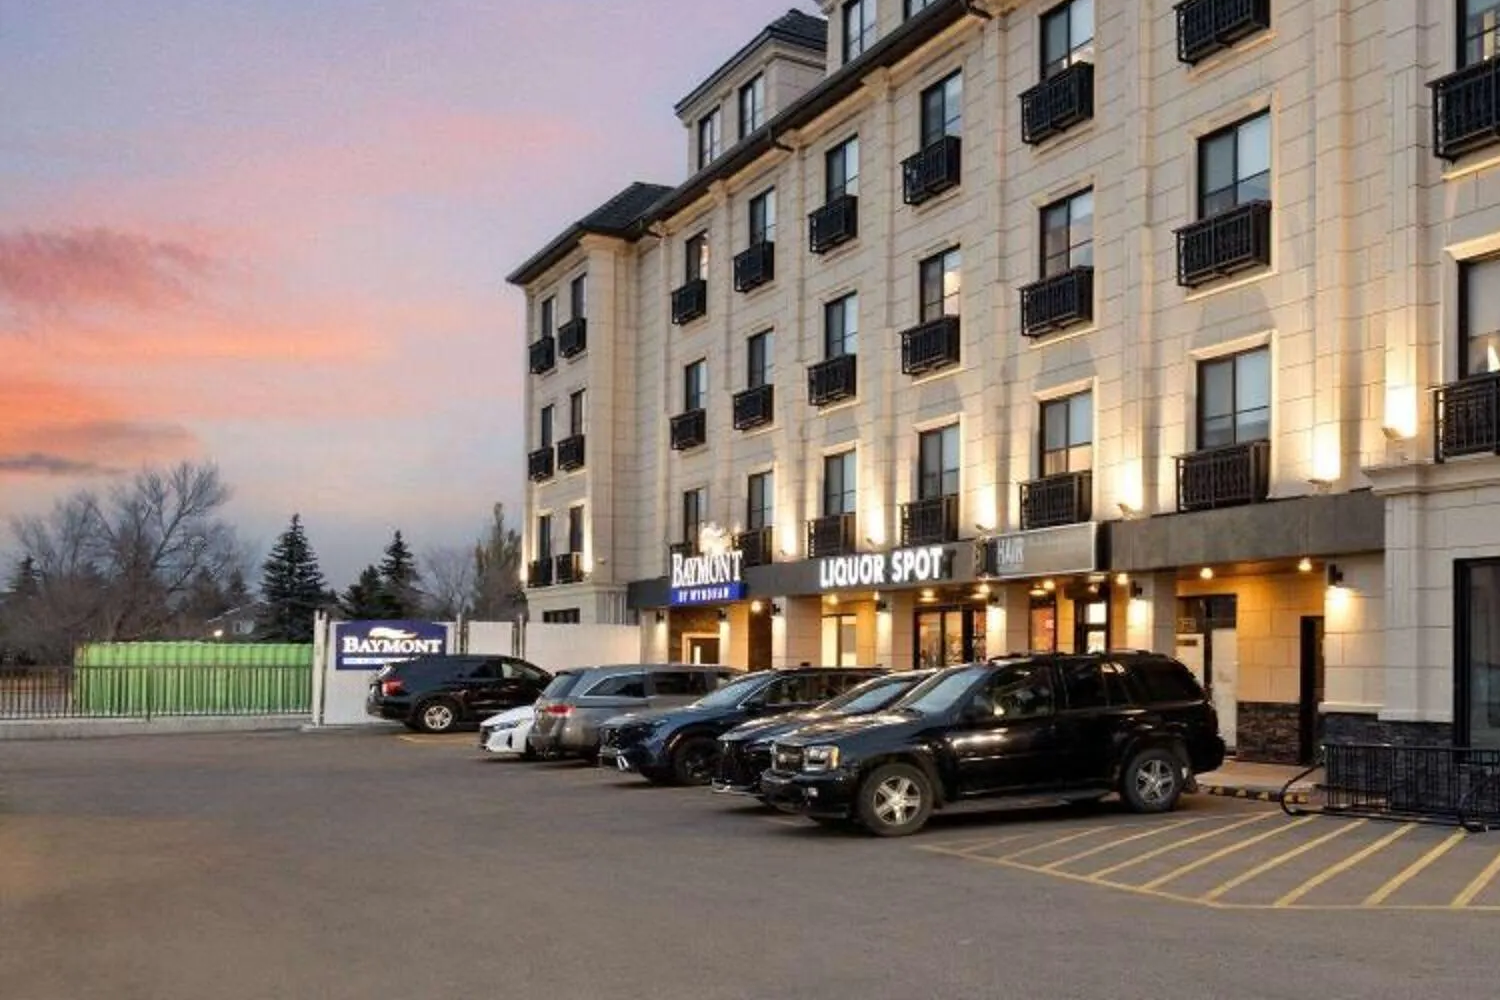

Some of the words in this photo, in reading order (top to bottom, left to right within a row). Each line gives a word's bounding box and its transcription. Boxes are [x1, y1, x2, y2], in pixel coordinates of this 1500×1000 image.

[671, 550, 743, 589] BAYMONT
[820, 554, 885, 588] LIQUOR
[891, 547, 943, 582] SPOT
[343, 635, 442, 653] BAYMONT
